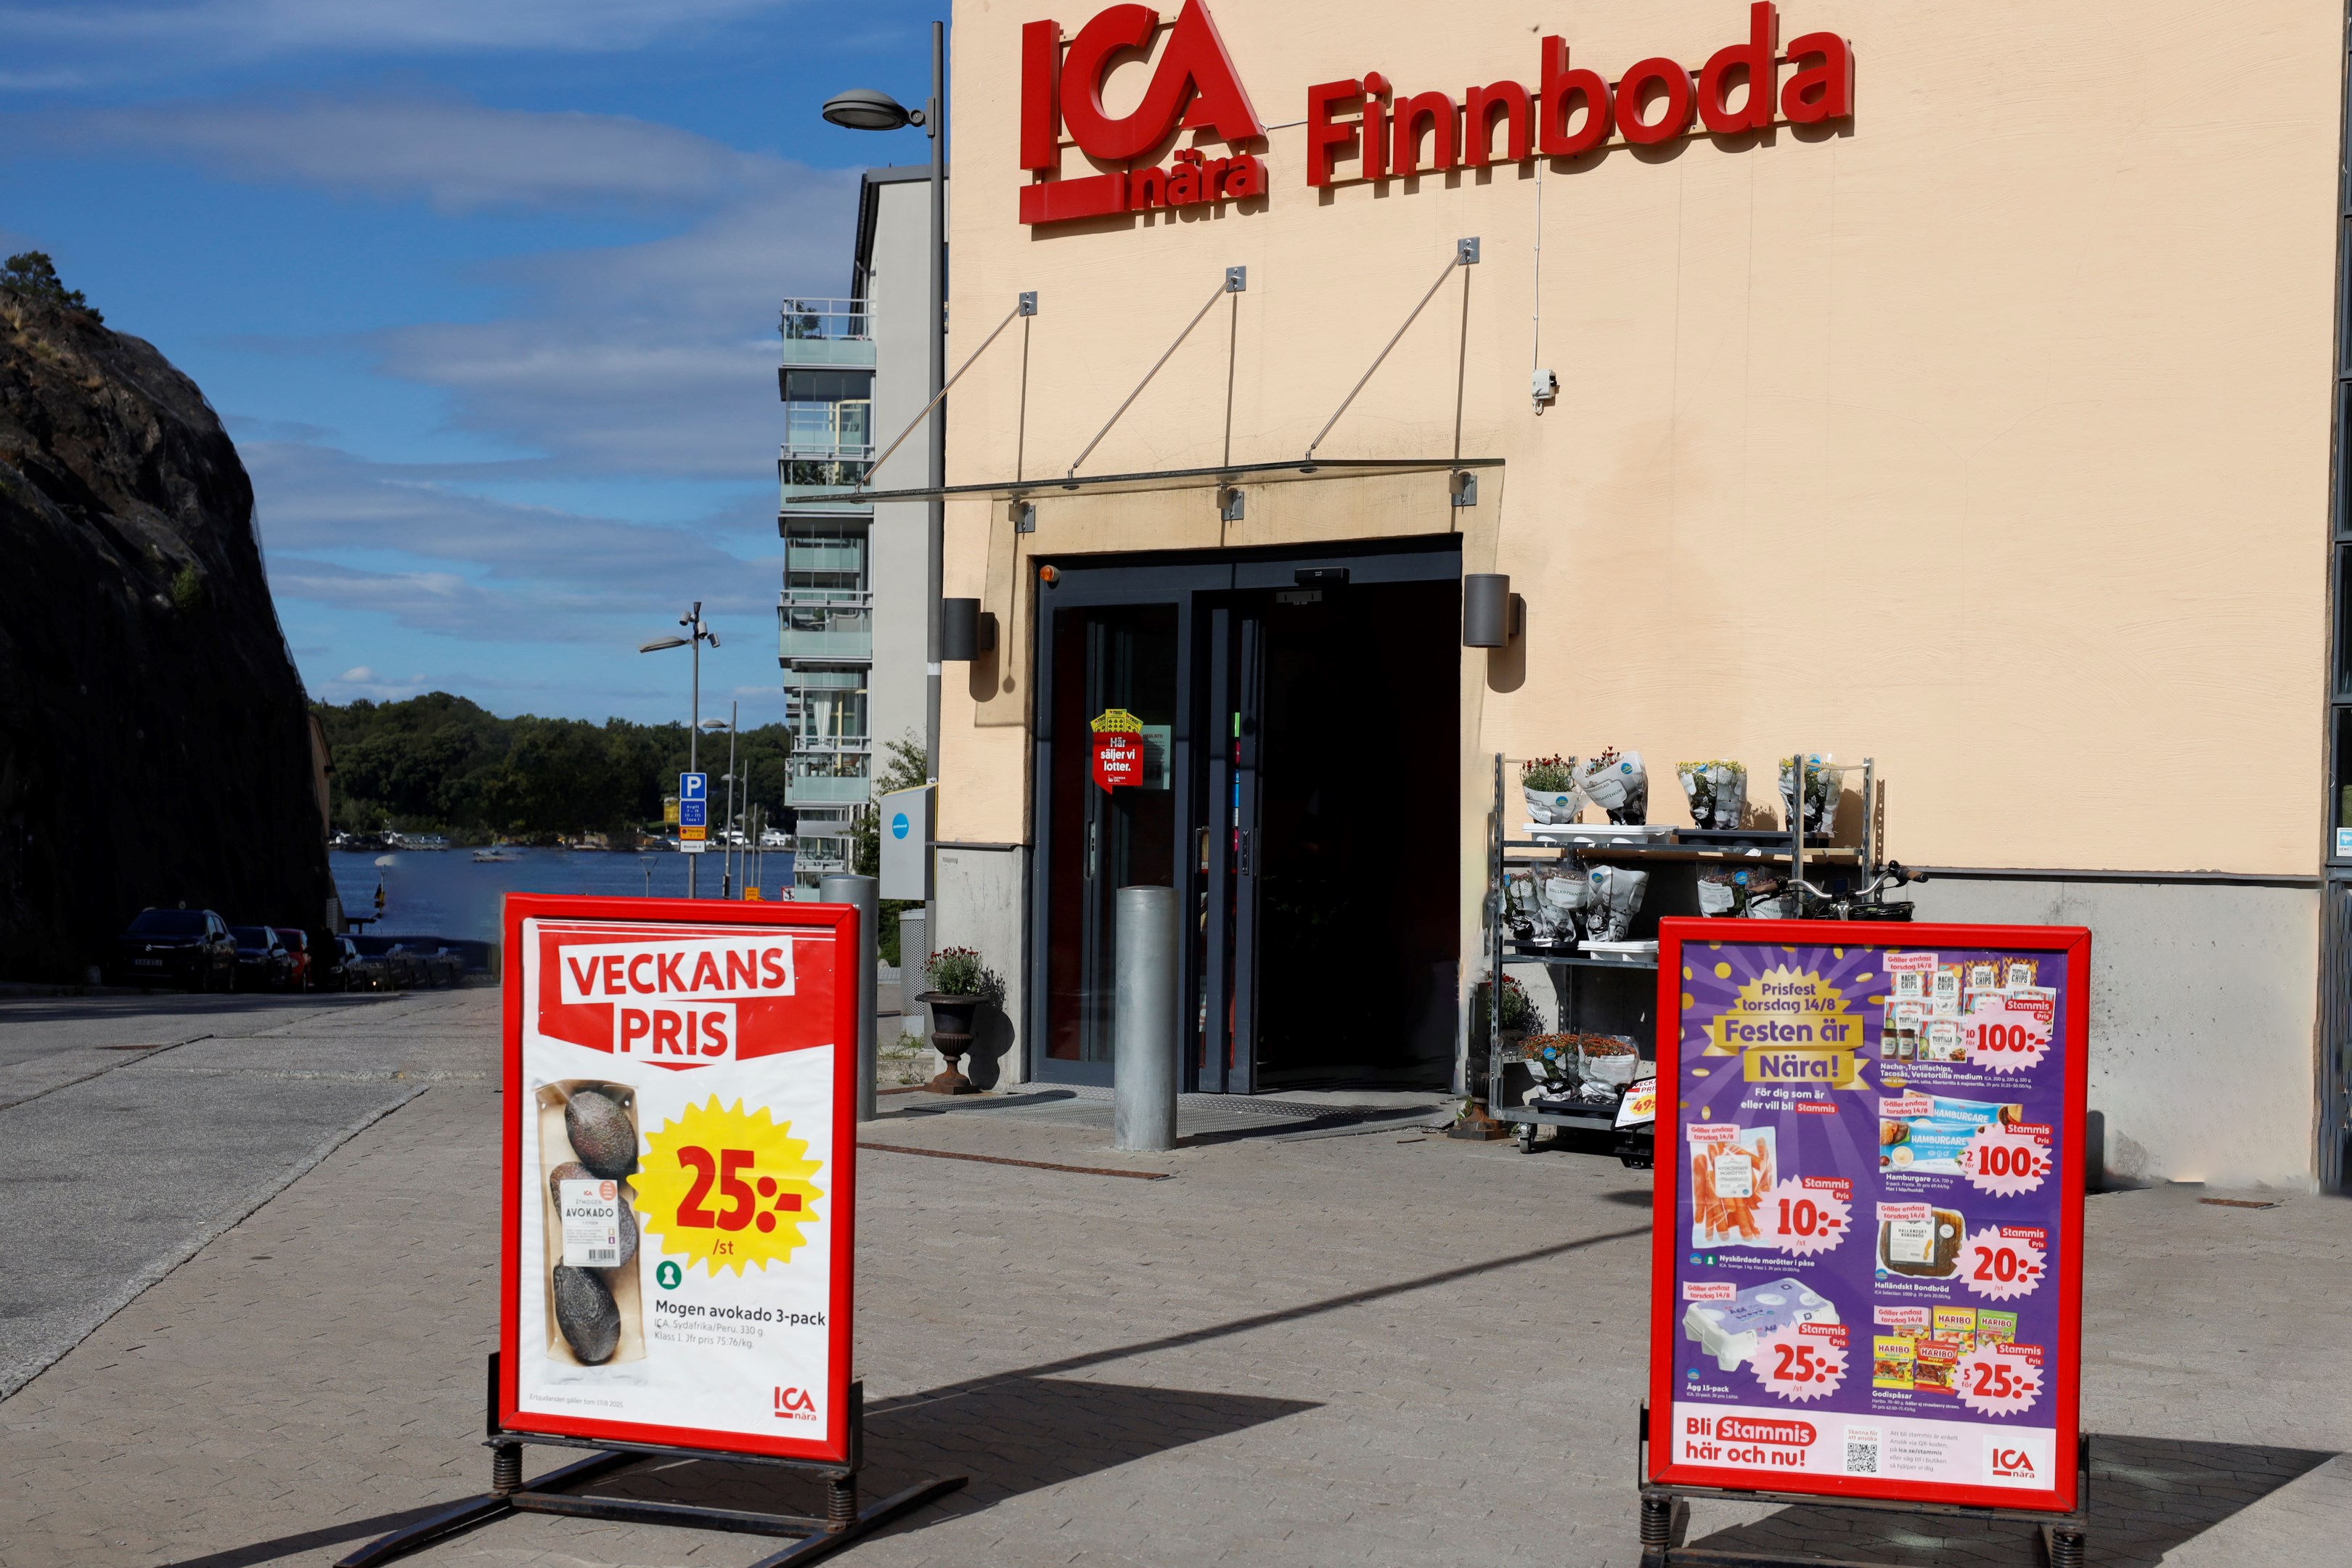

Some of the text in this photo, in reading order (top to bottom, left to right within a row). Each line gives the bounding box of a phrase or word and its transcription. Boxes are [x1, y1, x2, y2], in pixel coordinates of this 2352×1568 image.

[1020, 0, 1854, 187] ICA Finnboda
[1131, 147, 1267, 211] nära
[1111, 738, 1126, 748] Här
[1101, 749, 1125, 761] säljer
[1127, 749, 1135, 759] vi
[1104, 761, 1131, 771] lotter.
[687, 776, 701, 797] P
[567, 947, 787, 997] VECKANS
[1762, 983, 1816, 996] Prisfest
[1742, 999, 1836, 1013] torsdag 14/8
[2008, 1001, 2049, 1010] Stammis
[620, 1008, 727, 1057] PRIS
[1725, 1018, 1850, 1042] Festen är
[1966, 1024, 2045, 1053] 10 100:-
[1760, 1054, 1838, 1077] Nära!
[1881, 1070, 1910, 1079] Tacosås,
[1755, 1087, 1771, 1098] För
[1773, 1088, 1789, 1099] dig
[1814, 1090, 1824, 1099] är
[1741, 1101, 1835, 1114] eller vill bli Stammis
[1934, 1108, 1989, 1123] HAMBURGARE
[2008, 1124, 2050, 1134] Stammis
[1911, 1135, 1967, 1146] HAMBURGARE
[1967, 1146, 2051, 1177] 2 100:-
[676, 1146, 801, 1233] 25:-
[1805, 1178, 1850, 1189] Stammis
[566, 1208, 614, 1217] AVOKADO
[1777, 1199, 1841, 1237] 10:-
[2002, 1228, 2044, 1238] Stammis
[713, 1238, 734, 1256] /st
[1719, 1254, 1761, 1265] Nyskördade
[1799, 1259, 1815, 1267] påse
[1974, 1246, 2040, 1283] 20:-
[1914, 1283, 1950, 1292] Bondbröd
[656, 1299, 826, 1326] Mogen avokado 3-pack
[1938, 1315, 1971, 1324] HARIBO
[1982, 1318, 2012, 1328] HARIBO
[655, 1318, 765, 1337] ICA. Sydafrika/Peru. 330 g.
[1802, 1324, 1845, 1336] Stammis
[655, 1331, 675, 1342] Klass
[698, 1336, 714, 1345] pris
[1878, 1344, 1910, 1353] HARIBO
[1921, 1348, 1953, 1359] HARIBO
[1999, 1344, 2041, 1355] Stammis
[1773, 1344, 1838, 1383] 25:-
[1686, 1382, 1702, 1392] Ägg
[1964, 1362, 2034, 1399] 5 25:-
[530, 1394, 565, 1402] Erbjudandet
[775, 1386, 815, 1412] ICA
[1871, 1391, 1912, 1400] Godispåsar
[794, 1411, 817, 1421] nära
[1687, 1417, 1810, 1443] Bli Stammis
[1686, 1441, 1805, 1467] här och nu!
[1993, 1449, 2035, 1471] ICA
